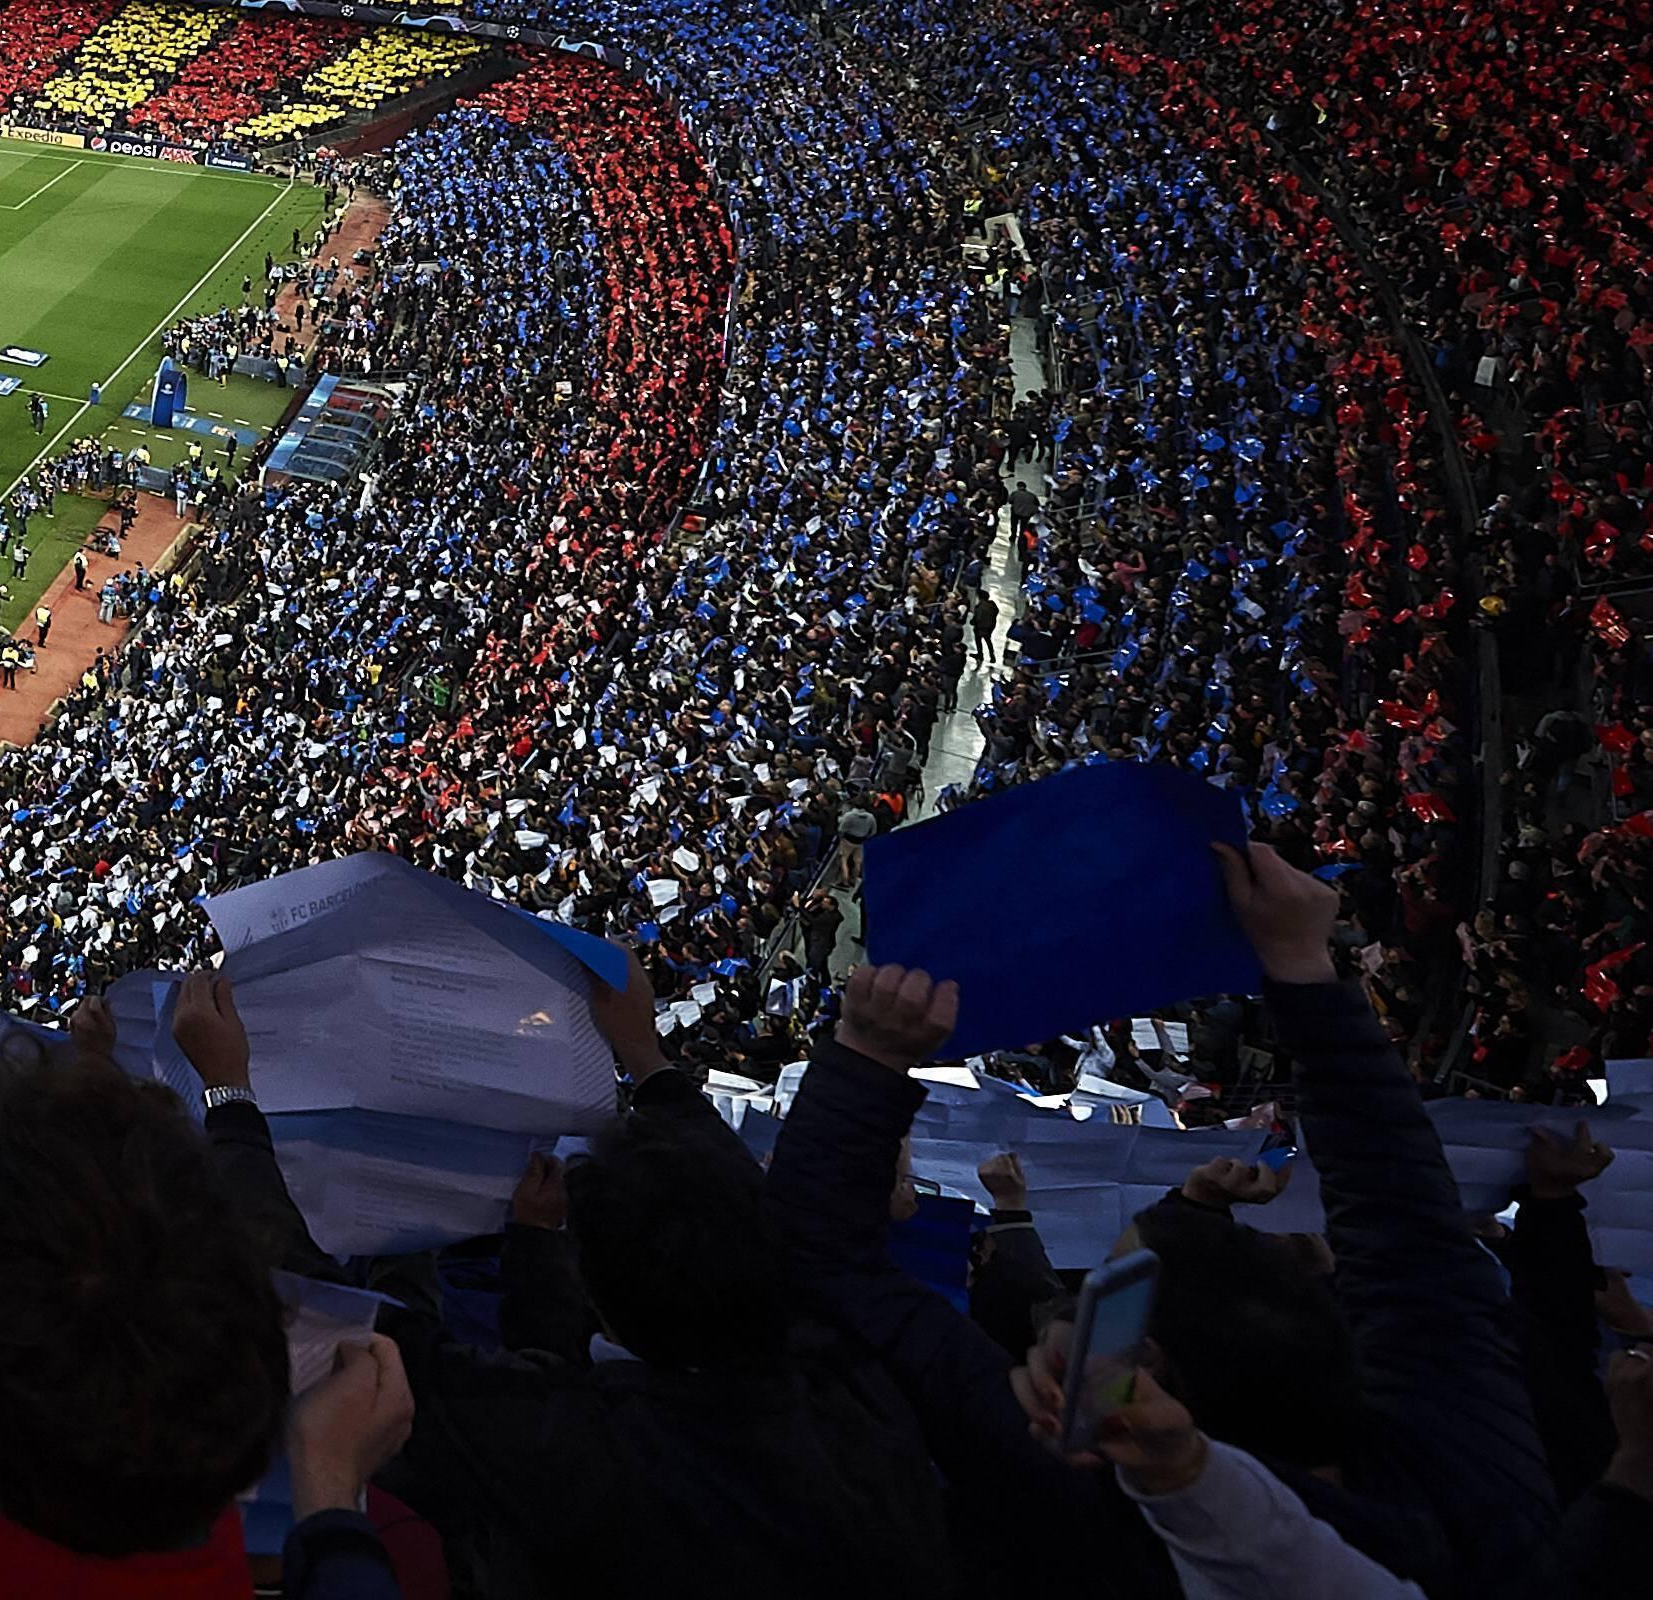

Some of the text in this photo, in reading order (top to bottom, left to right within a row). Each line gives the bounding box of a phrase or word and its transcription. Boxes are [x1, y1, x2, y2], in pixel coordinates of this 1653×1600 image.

[8, 127, 63, 145] Expedia
[110, 140, 157, 158] pepsi
[289, 903, 308, 923] FC
